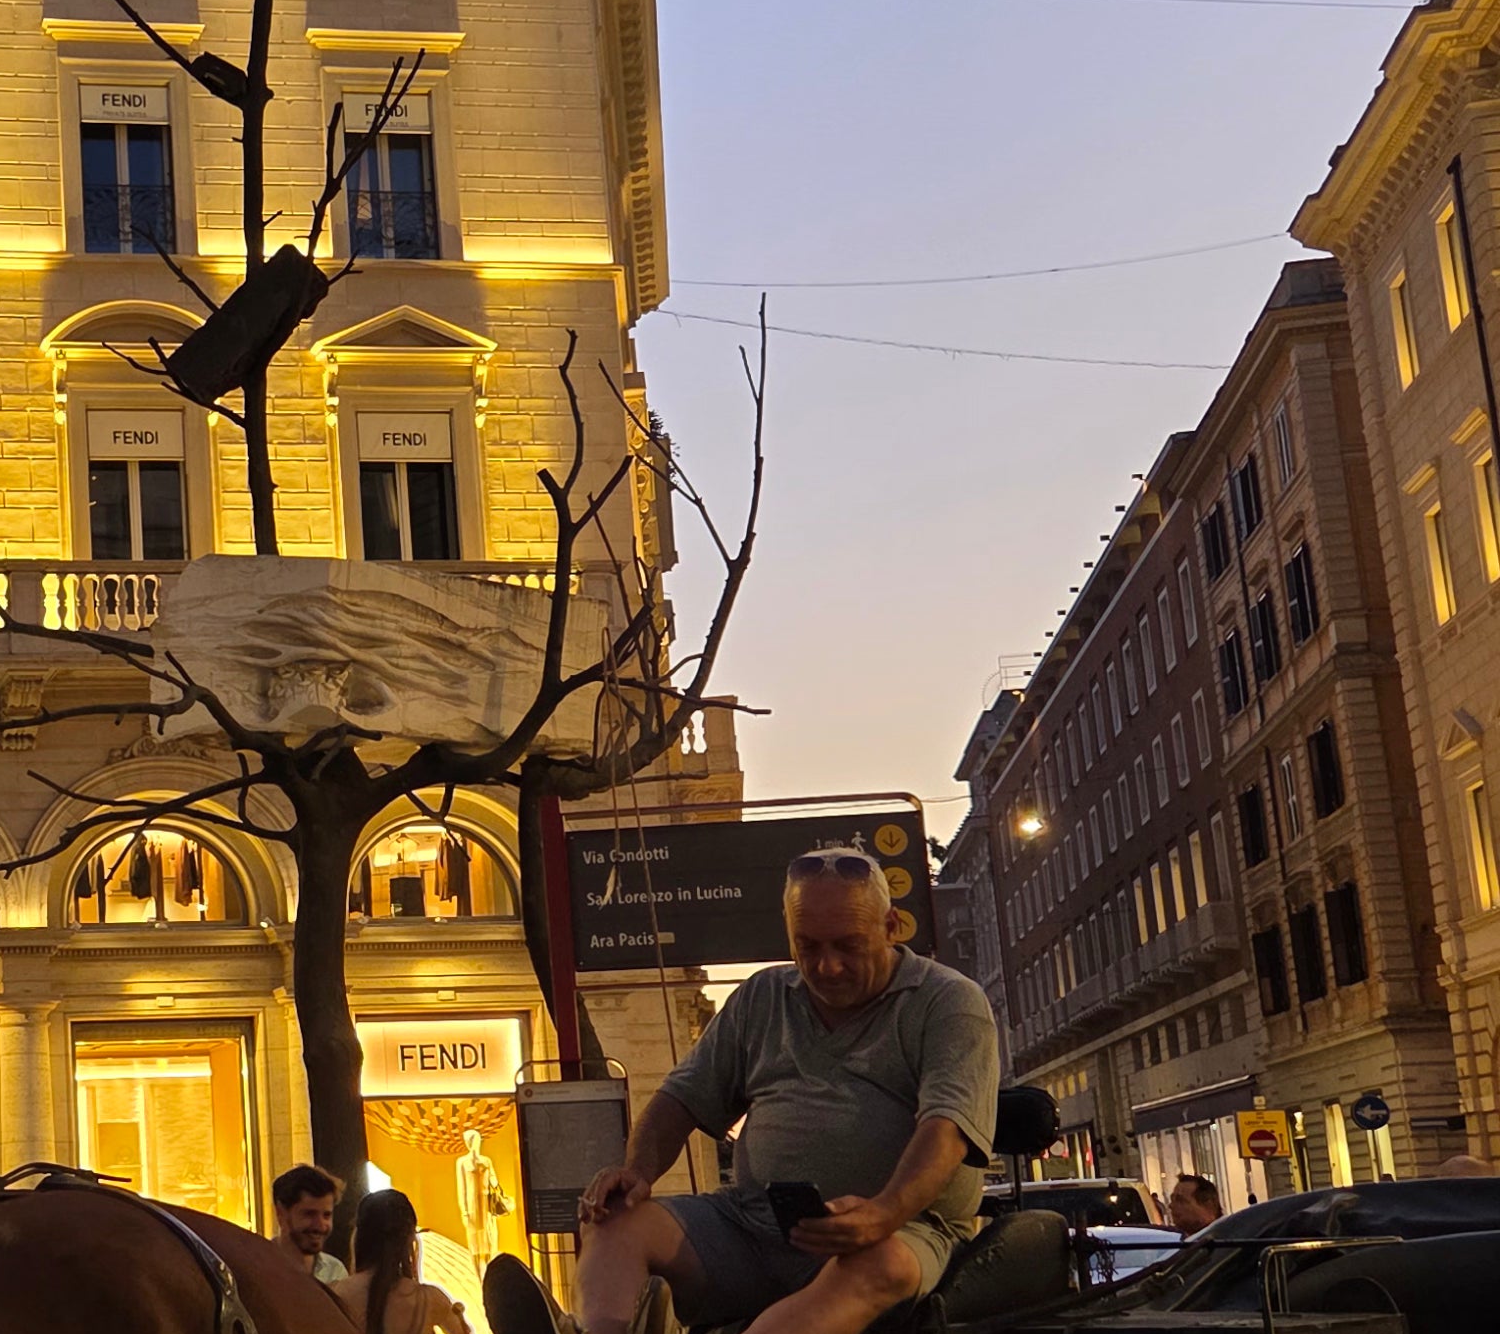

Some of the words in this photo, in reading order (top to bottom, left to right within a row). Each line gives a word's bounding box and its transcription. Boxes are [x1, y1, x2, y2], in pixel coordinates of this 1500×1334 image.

[102, 93, 147, 108] FENDI
[113, 431, 159, 444] FENDI
[382, 432, 427, 446] FENDI
[583, 850, 605, 865] Via
[587, 892, 612, 906] San
[617, 890, 673, 905] Lorenzo
[678, 887, 691, 901] in
[696, 885, 742, 900] Lucina
[590, 934, 614, 948] Ara
[619, 931, 655, 946] Pacis
[399, 1043, 486, 1071] FENDI
